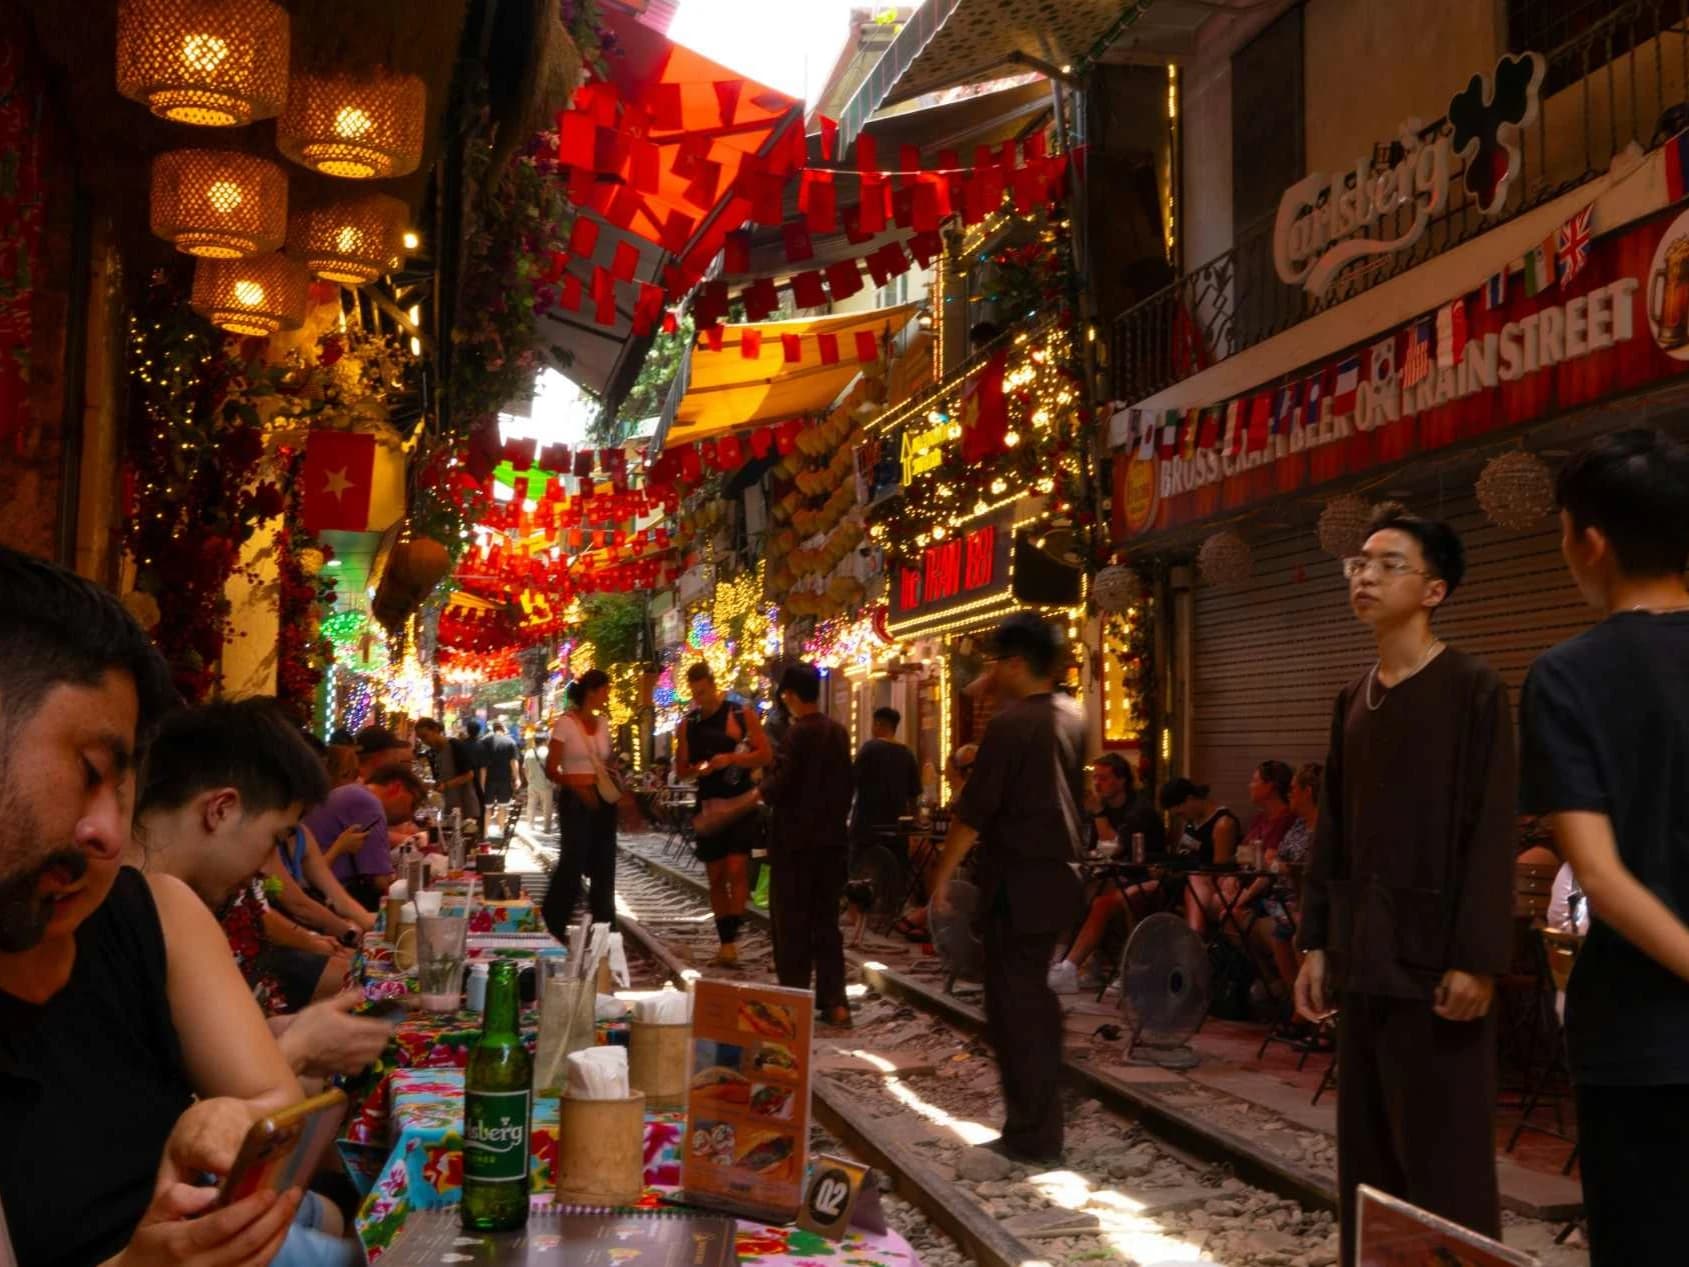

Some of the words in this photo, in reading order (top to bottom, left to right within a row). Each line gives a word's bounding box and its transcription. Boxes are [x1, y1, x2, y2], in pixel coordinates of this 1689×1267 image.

[1273, 128, 1452, 286] Carlsberg
[1498, 277, 1640, 381] STREET
[815, 1177, 848, 1217] 02
